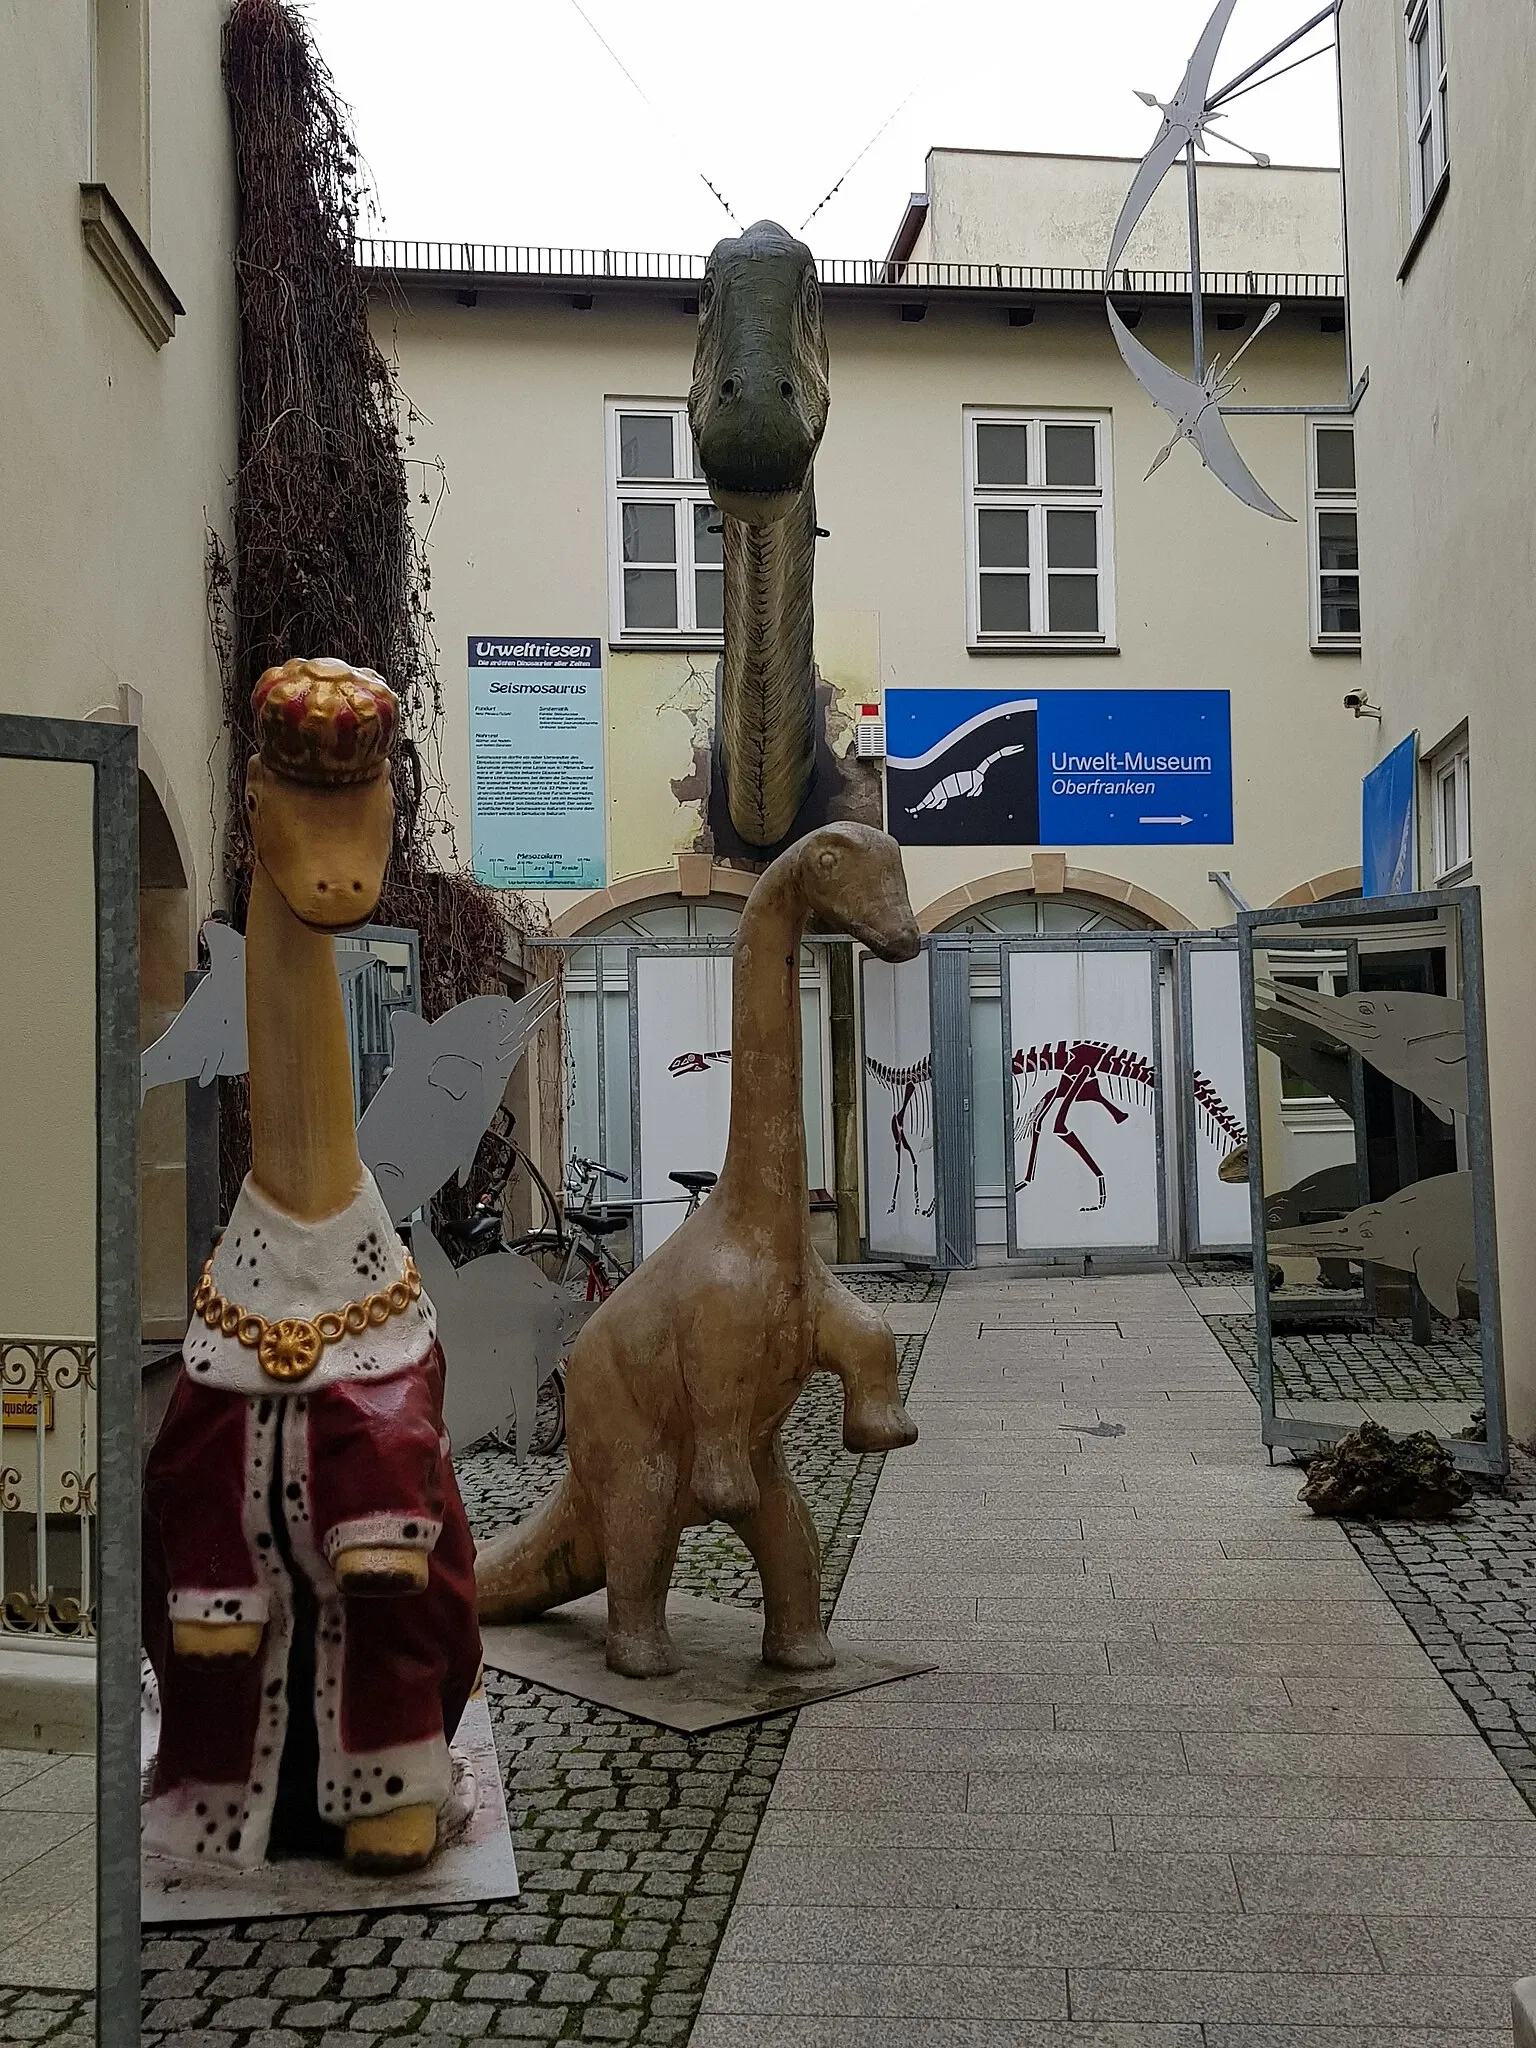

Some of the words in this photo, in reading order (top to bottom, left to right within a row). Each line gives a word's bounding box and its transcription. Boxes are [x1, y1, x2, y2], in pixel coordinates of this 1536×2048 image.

[476, 642, 591, 657] Urweltriesen
[489, 682, 587, 694] Seismosaurus
[1051, 751, 1212, 771] Urwelt-Museum
[1051, 779, 1155, 795] Oberfranken
